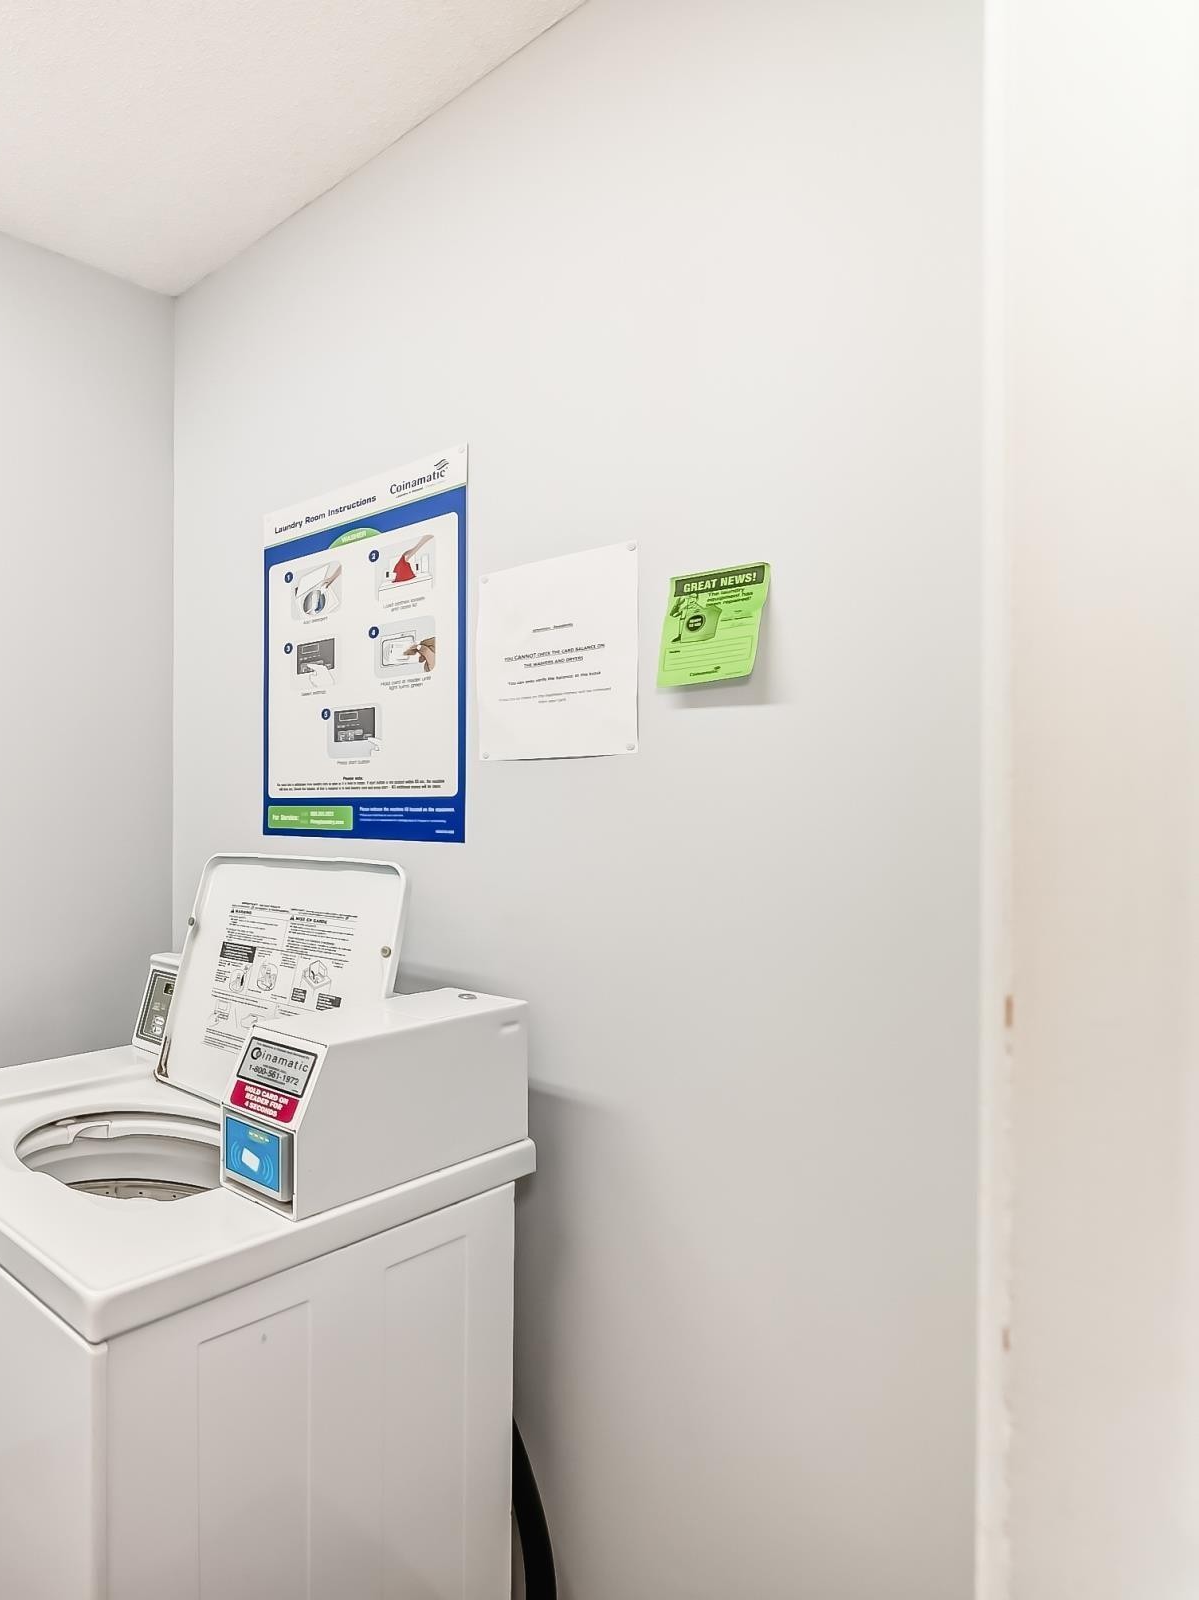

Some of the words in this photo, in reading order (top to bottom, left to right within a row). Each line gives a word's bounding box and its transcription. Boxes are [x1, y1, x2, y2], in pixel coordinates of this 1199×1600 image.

[390, 470, 446, 494] Coinamatic
[274, 521, 303, 534] Laundry
[305, 513, 326, 524] Room
[327, 495, 377, 517] Instructions
[683, 579, 717, 593] GREAT
[720, 572, 757, 587] NEWS!
[249, 1064, 299, 1086] 1-800-561-1972
[244, 1085, 261, 1095] HOLD
[262, 1091, 279, 1101] CARD
[279, 1097, 289, 1106] ON
[245, 1092, 269, 1106] READER
[269, 1101, 283, 1110] FOR
[249, 1102, 278, 1117] SECONDS
